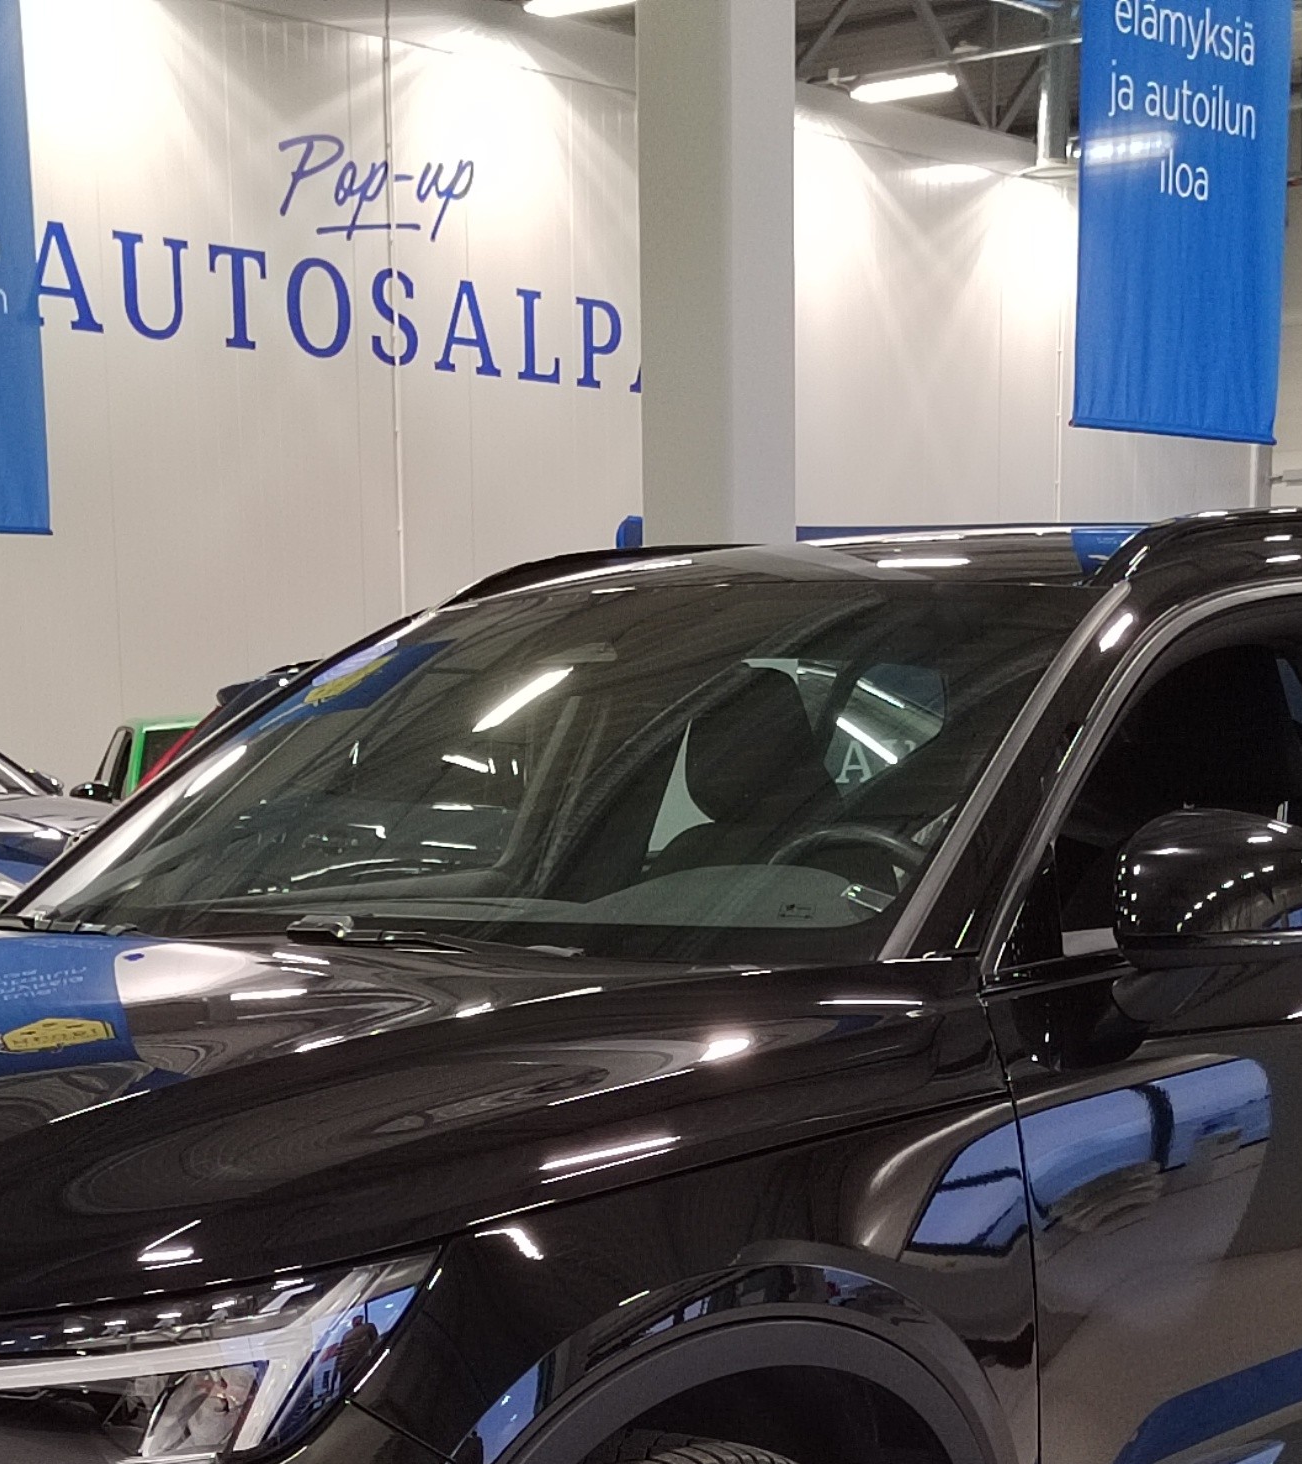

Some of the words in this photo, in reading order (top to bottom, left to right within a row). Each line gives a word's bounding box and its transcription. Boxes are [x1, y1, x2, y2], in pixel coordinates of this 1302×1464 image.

[1108, 59, 1135, 117] ja
[1145, 79, 1256, 141] autoilun
[277, 133, 476, 242] Pop-up
[1160, 149, 1210, 201] iloa
[35, 220, 642, 394] AUTOSALP
